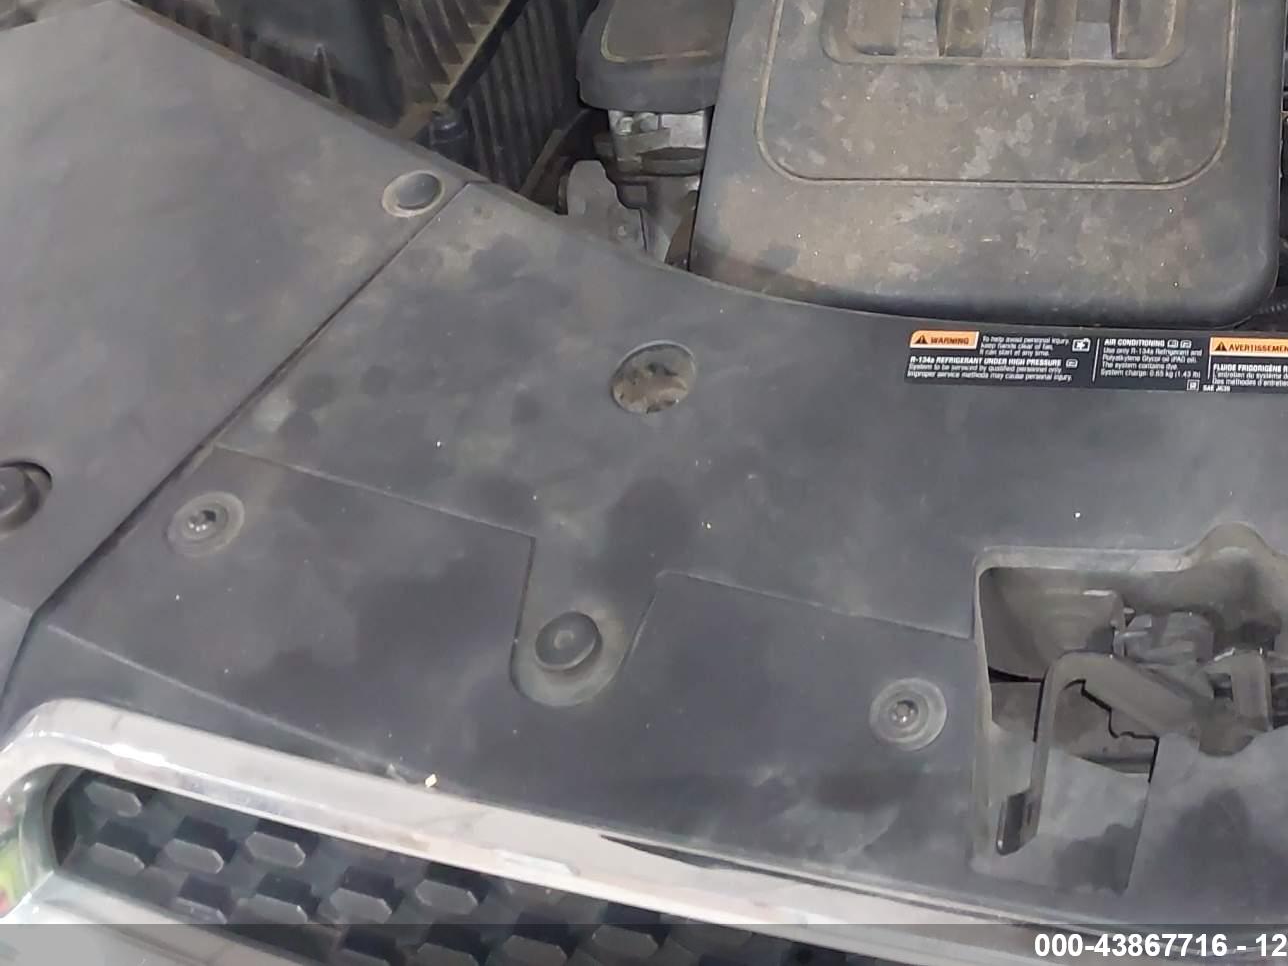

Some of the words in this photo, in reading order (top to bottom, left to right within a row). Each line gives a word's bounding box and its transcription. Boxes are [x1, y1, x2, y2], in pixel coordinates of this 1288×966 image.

[930, 337, 970, 345] WARNING
[1118, 338, 1164, 347] CONDITIONING
[936, 356, 982, 364] REFRIGERANT
[1026, 358, 1061, 367] PRESSURE
[1214, 364, 1236, 372] FLUIDE
